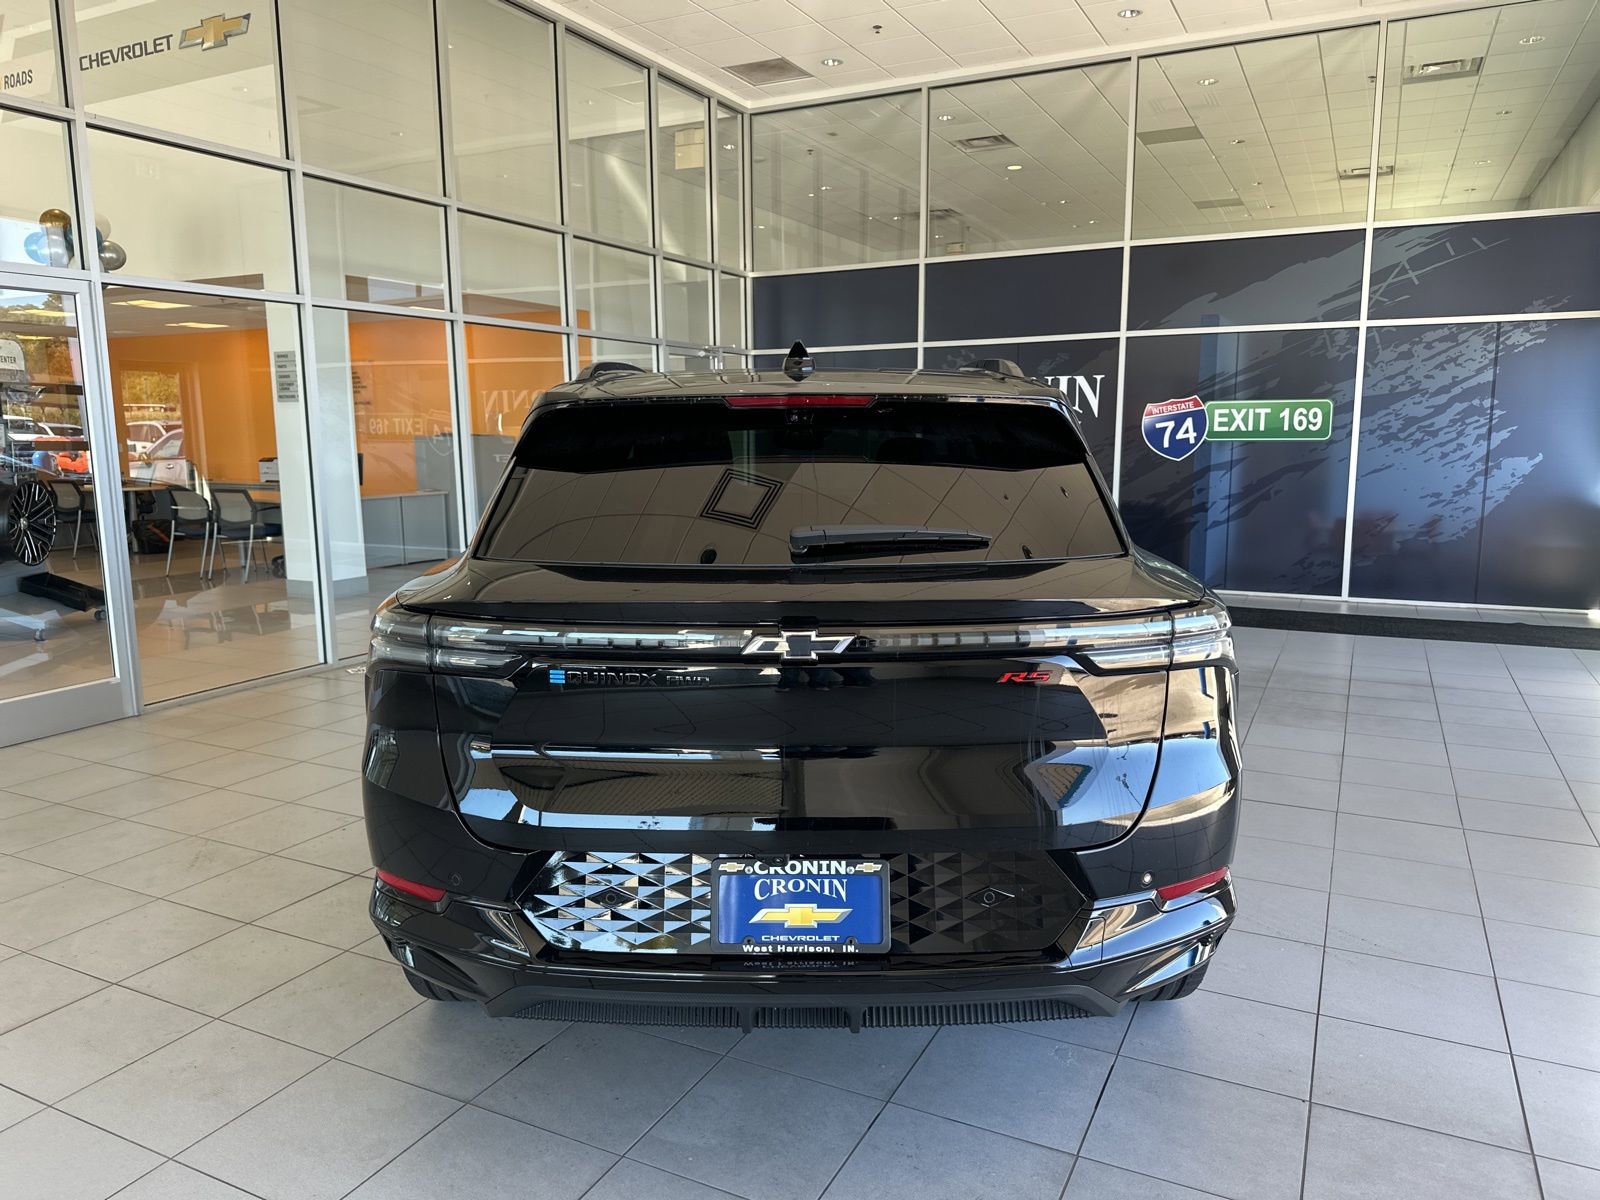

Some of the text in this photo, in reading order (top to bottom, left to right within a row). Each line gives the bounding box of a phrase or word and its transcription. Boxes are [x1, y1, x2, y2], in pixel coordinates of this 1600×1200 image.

[79, 34, 173, 71] CHEVROLET
[4, 69, 33, 90] ROADS
[0, 355, 16, 364] ENTER
[1151, 402, 1195, 415] INTERSTATE
[1213, 407, 1323, 432] EXIT 169
[1155, 417, 1197, 449] 74
[549, 669, 657, 686] EQUINOX
[994, 670, 1052, 684] RS
[754, 878, 848, 903] CRONIN
[742, 945, 859, 954] West Harrison, IN.
